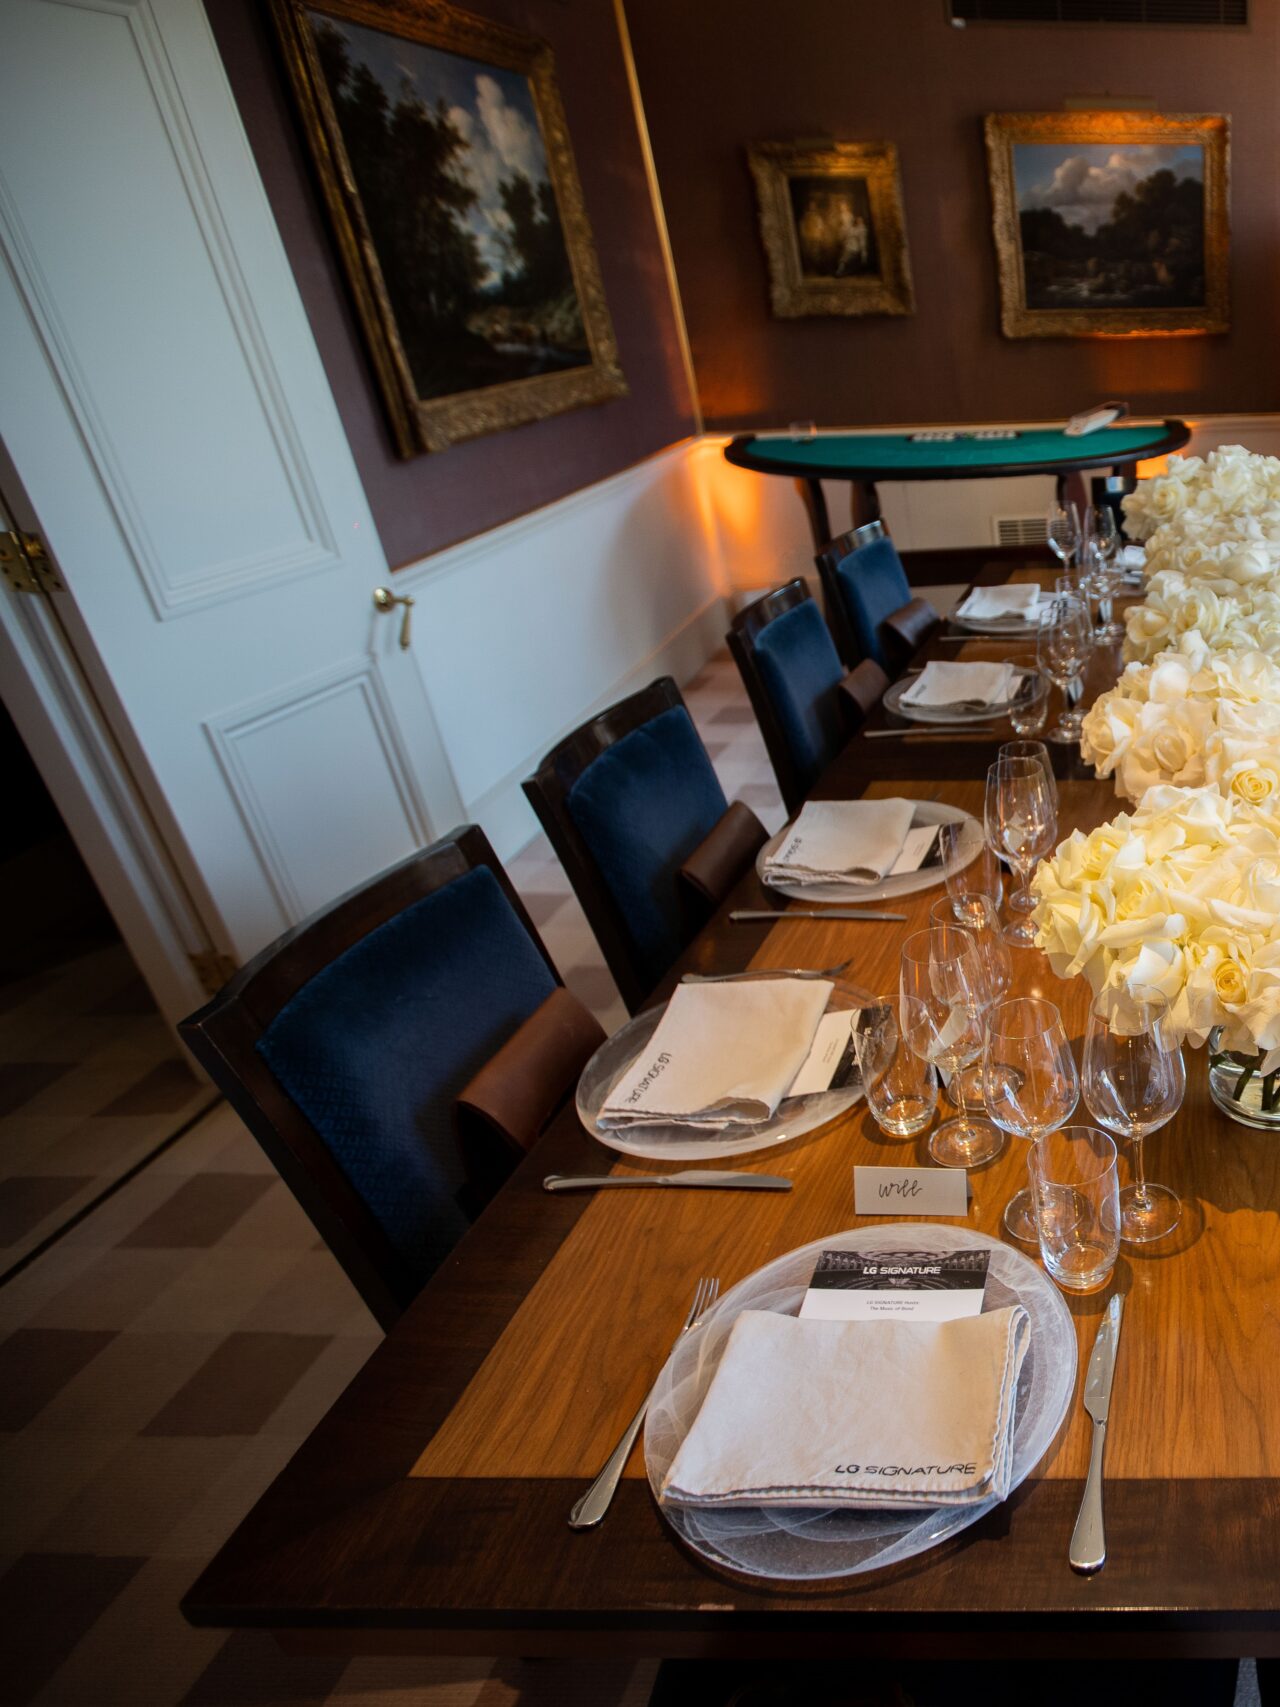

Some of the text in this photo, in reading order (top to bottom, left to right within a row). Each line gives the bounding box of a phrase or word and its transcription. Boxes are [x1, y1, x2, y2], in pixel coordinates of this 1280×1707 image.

[878, 1179, 923, 1199] will
[863, 1266, 942, 1275] LG SIGNATURE
[835, 1462, 977, 1476] LG SIGNATURE
